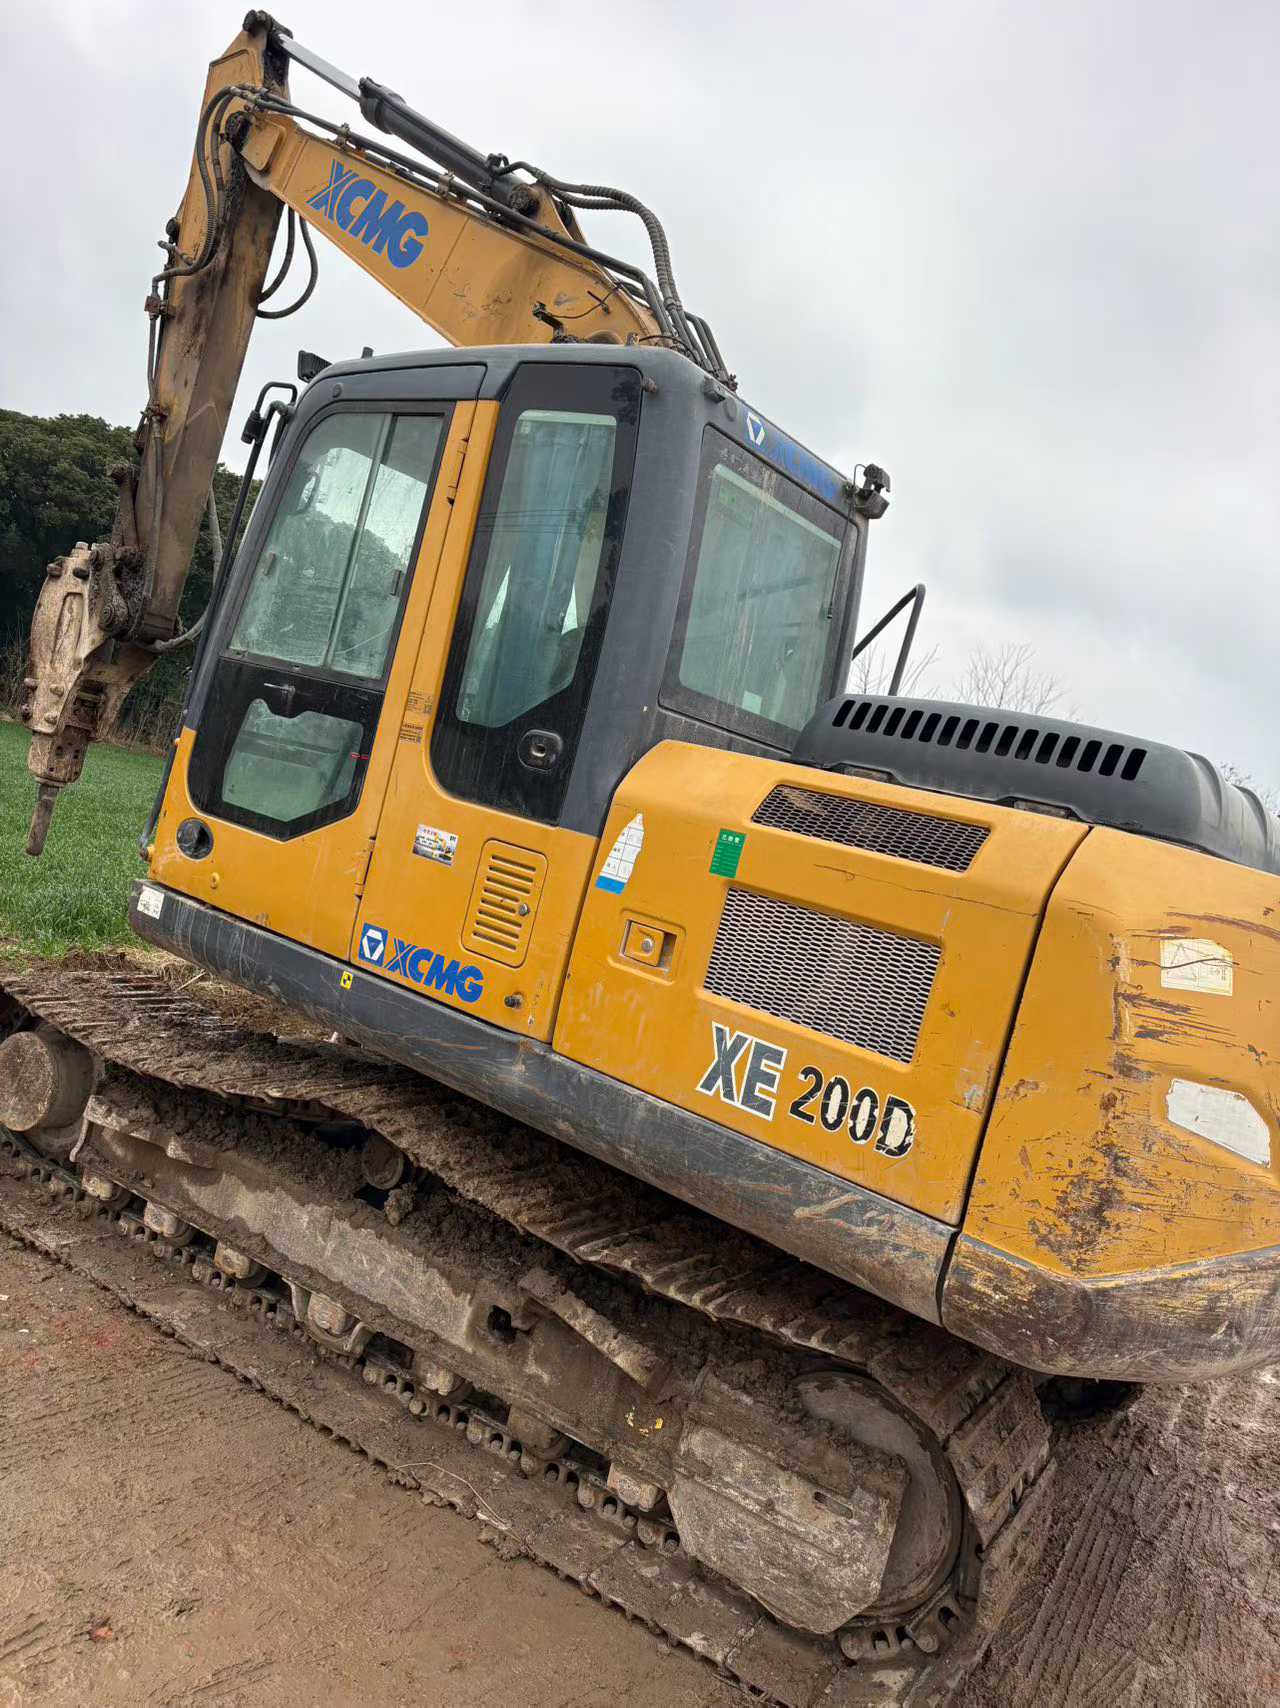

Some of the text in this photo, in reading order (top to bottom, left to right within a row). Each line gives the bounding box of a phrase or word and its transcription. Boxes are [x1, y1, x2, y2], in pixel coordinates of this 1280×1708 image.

[305, 159, 429, 269] XCMG
[384, 937, 484, 1004] XCMG
[696, 1021, 917, 1158] XE 200D
